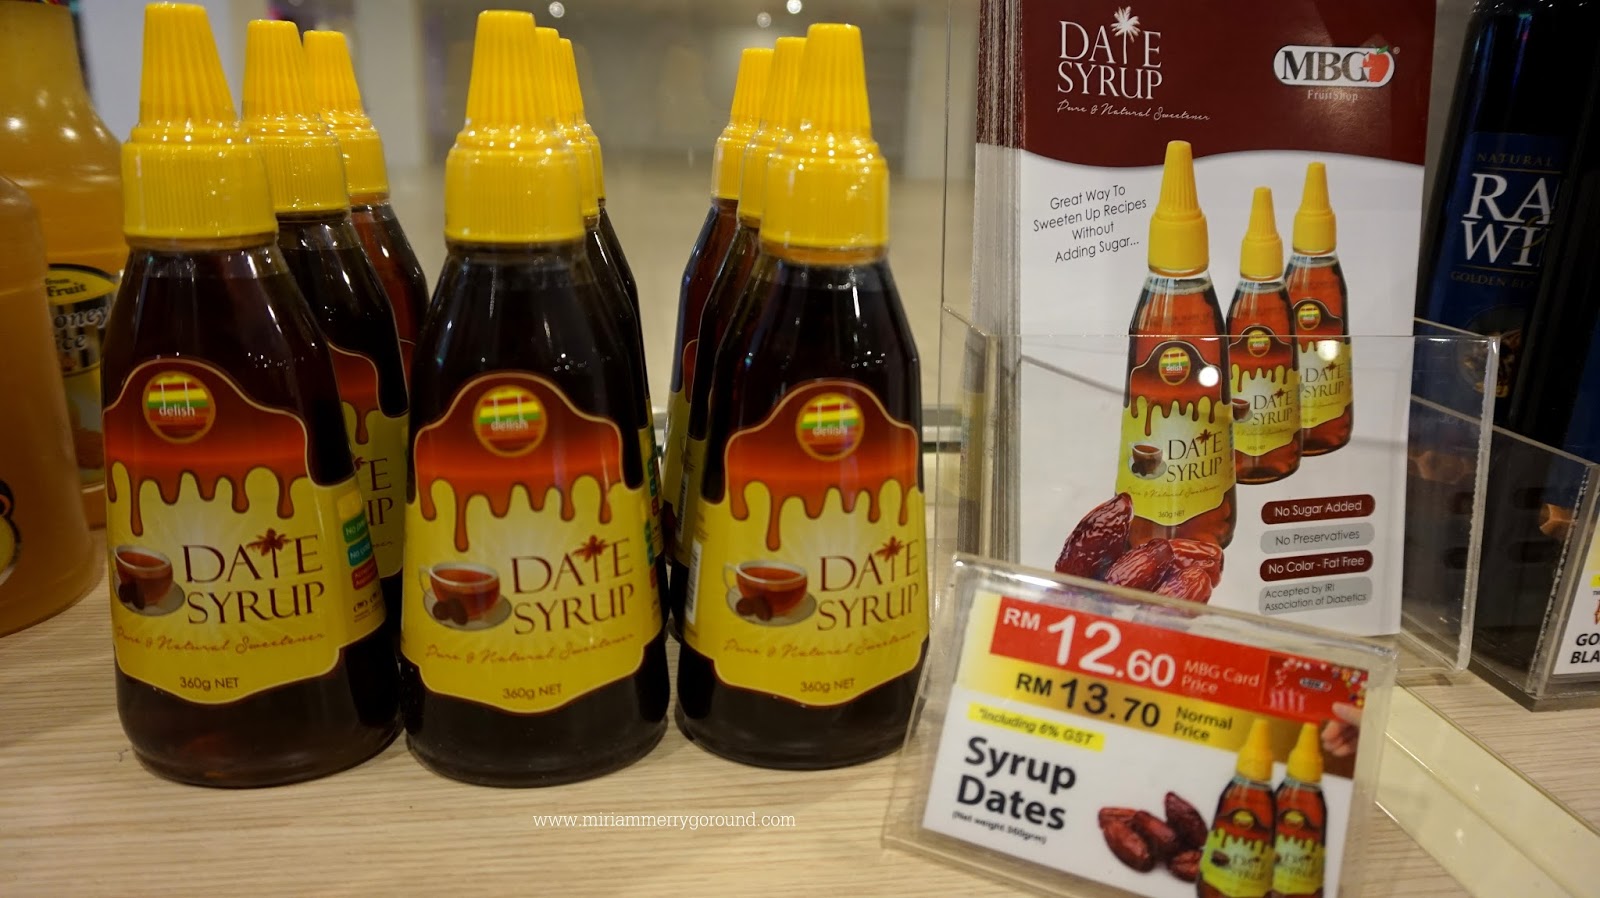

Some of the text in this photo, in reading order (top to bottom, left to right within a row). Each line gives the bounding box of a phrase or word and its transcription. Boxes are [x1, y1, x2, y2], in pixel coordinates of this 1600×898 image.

[1058, 12, 1161, 69] DATE
[1281, 50, 1370, 83] MBG
[1057, 61, 1162, 100] SYRUP
[1307, 89, 1359, 103] FruitShop
[1057, 99, 1211, 121] Pure & Natural Sweetener
[1476, 152, 1553, 167] NATURAL
[1050, 184, 1126, 210] Great Way To
[1463, 173, 1552, 225] RA
[1033, 199, 1147, 232] Sweeten Up Recipes
[1072, 221, 1114, 240] Without
[1055, 237, 1140, 263] Adding Sugar...
[1461, 220, 1542, 267] WI
[54, 306, 110, 329] oney
[1305, 363, 1344, 383] DATE
[1253, 389, 1293, 410] DATE
[1304, 381, 1344, 398] SYRUP
[158, 392, 195, 418] delish
[1252, 408, 1292, 426] SYRUP
[491, 406, 528, 432] delish
[1168, 430, 1223, 461] DATE
[1166, 456, 1222, 483] SYRUP
[1275, 500, 1362, 517] No Sugar Added
[1275, 529, 1360, 546] No Preservatives
[182, 530, 323, 584] DATE
[510, 536, 633, 594] DATE
[819, 537, 919, 593] DATE
[1268, 563, 1284, 574] No
[1286, 561, 1315, 573] Color
[1323, 558, 1340, 569] Fat
[1342, 556, 1365, 567] Free
[187, 580, 325, 625] SYRUP
[1265, 586, 1310, 599] Accepted
[1312, 585, 1322, 594] by
[1265, 593, 1367, 611] Association of Diabetics
[513, 583, 634, 635] SYRUP
[816, 583, 919, 632] SYRUP
[157, 635, 230, 652] Natural
[235, 631, 325, 655] Sweetener
[1002, 606, 1177, 688] RM 12.60
[1576, 633, 1600, 647] GO
[1570, 650, 1600, 664] BLA
[179, 676, 240, 692] 360g NET
[800, 678, 855, 693] 360g NET
[1181, 676, 1218, 694] Price
[1184, 659, 1260, 688] MBG Card
[502, 683, 562, 700] 360g NET
[1016, 672, 1161, 728] RM 13.70
[1173, 720, 1210, 742] Price
[1175, 706, 1233, 731] Normal
[1039, 723, 1059, 738] 6%
[1062, 728, 1095, 746] GST
[965, 736, 1077, 795] Syrup
[957, 774, 1066, 831] Dates
